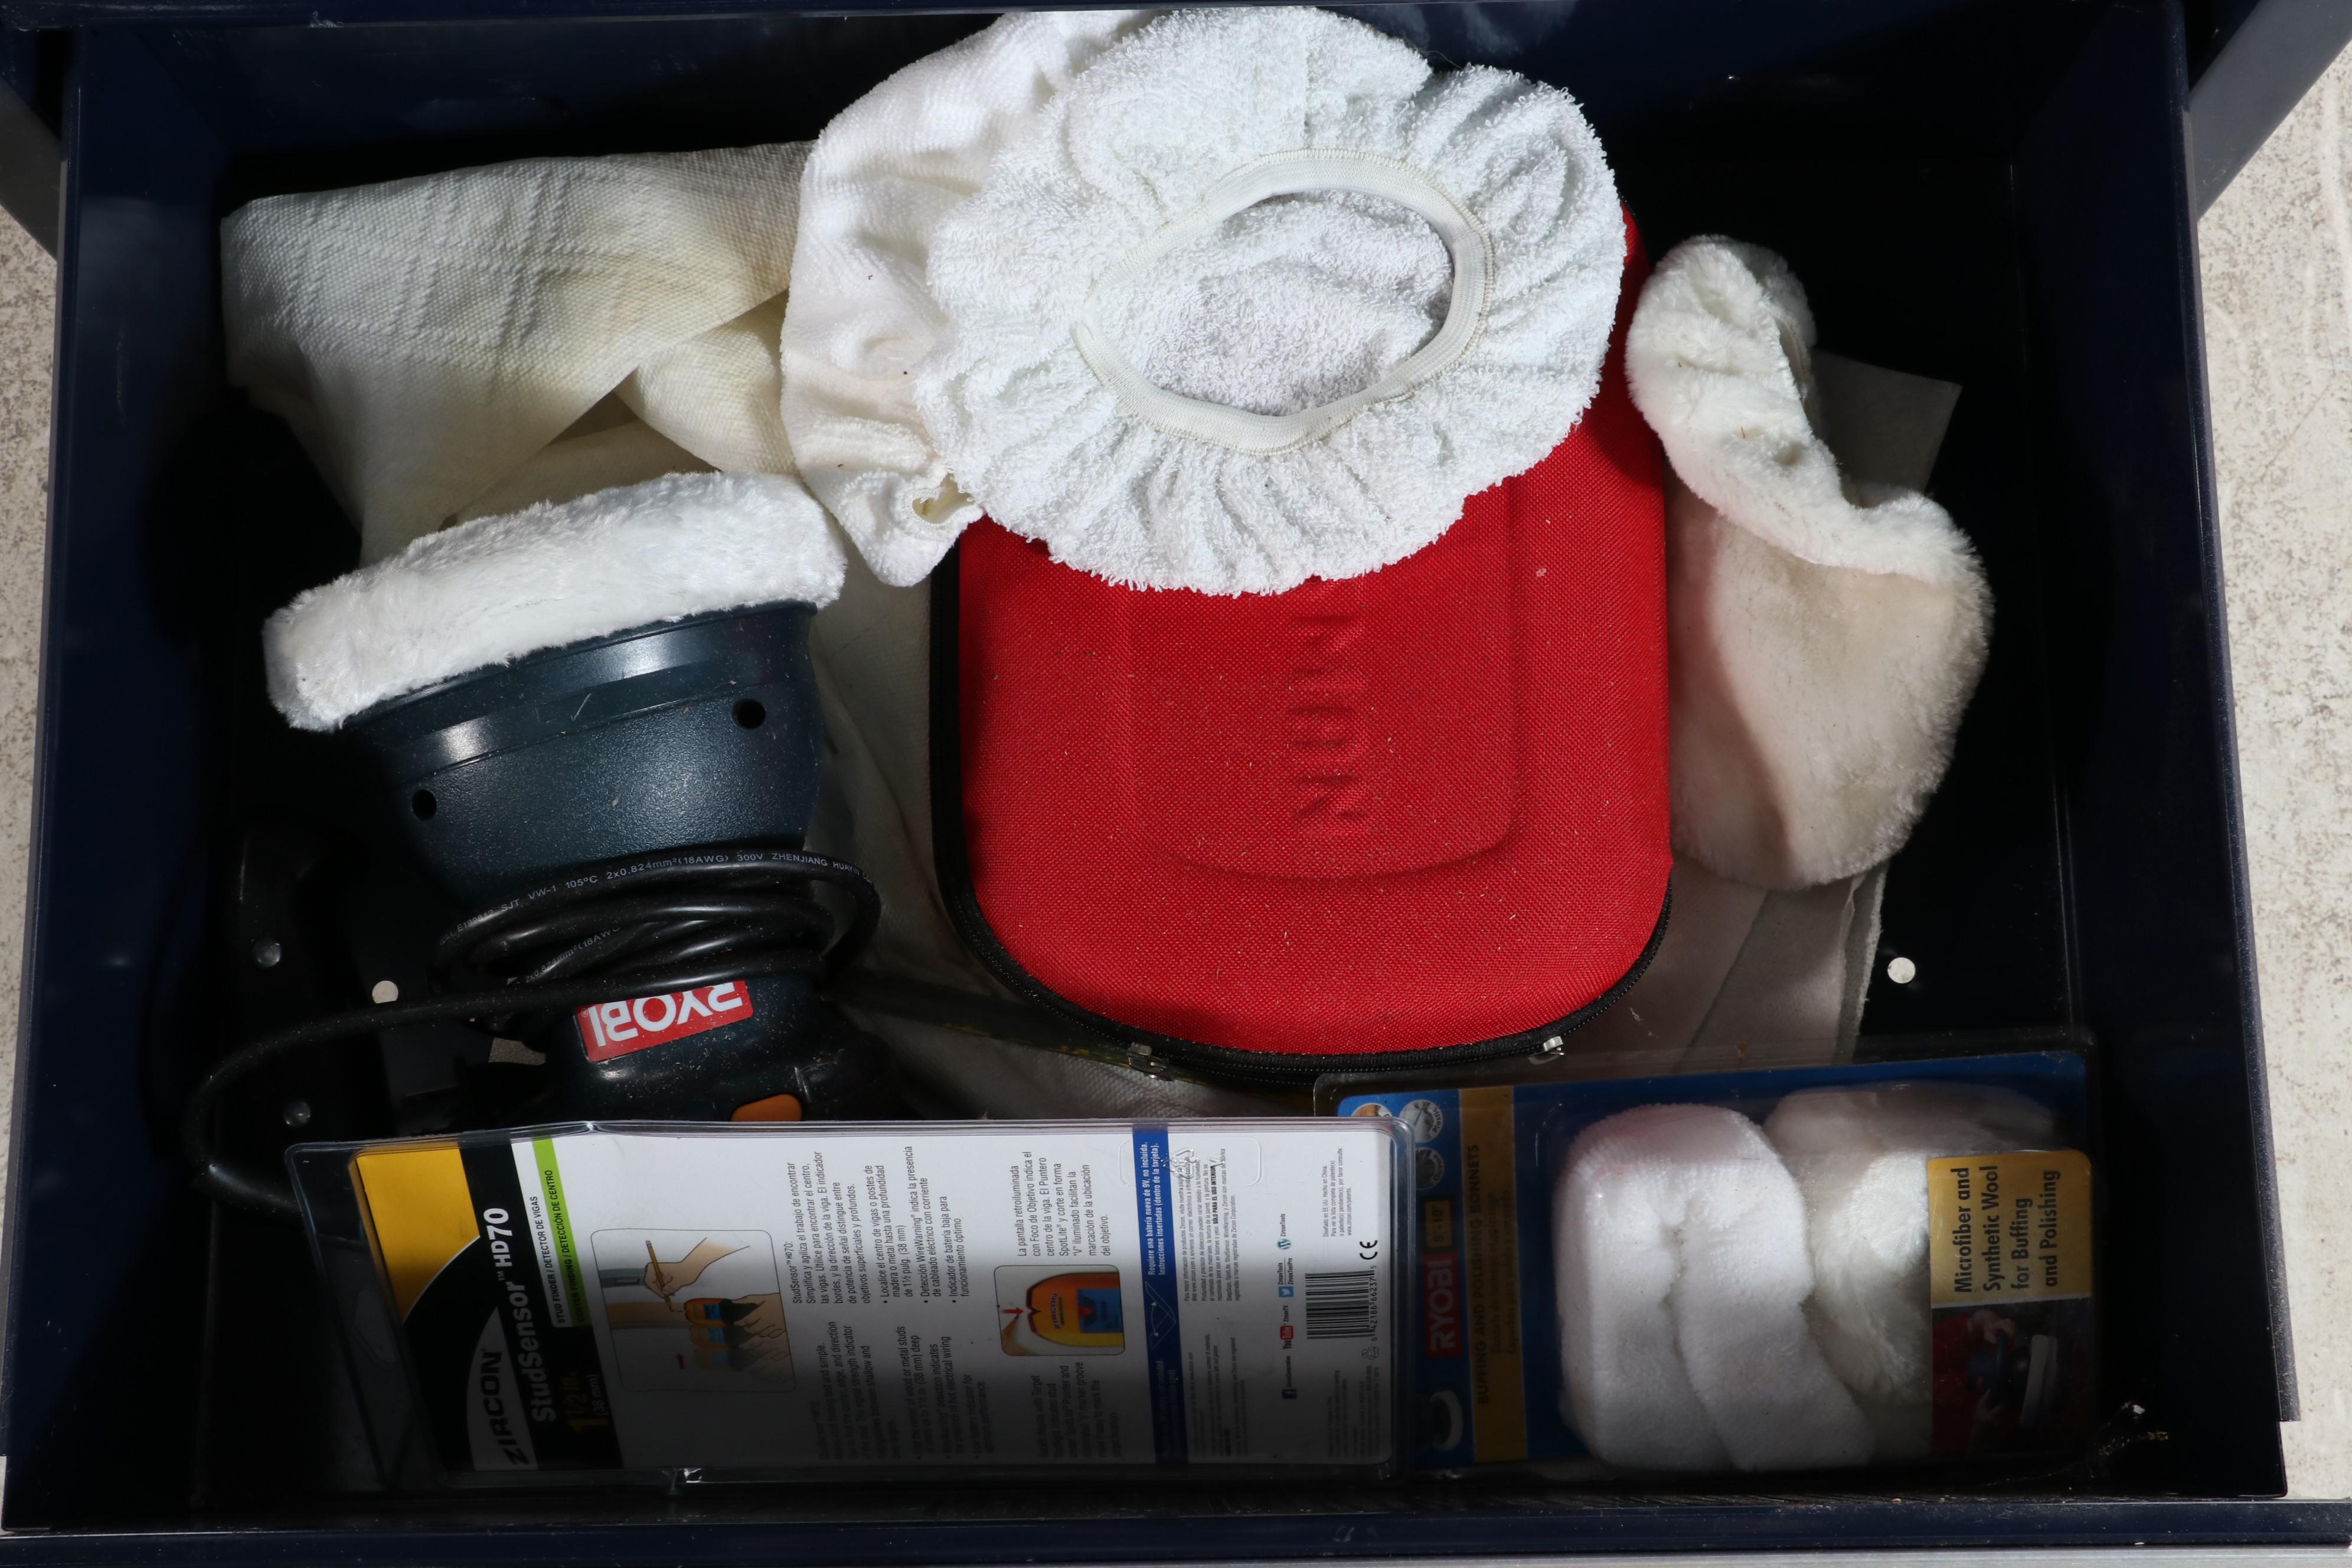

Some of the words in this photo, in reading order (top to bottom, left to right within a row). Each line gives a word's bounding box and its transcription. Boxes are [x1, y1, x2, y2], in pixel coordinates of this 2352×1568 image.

[501, 899, 520, 912] SJT
[528, 885, 557, 900] VW-1
[737, 852, 763, 862] 300V
[772, 852, 828, 867] ZHENJIANG
[588, 982, 743, 1046] RYOBI
[813, 1151, 827, 1184] indicador
[903, 1146, 918, 1180] presencia
[1139, 1142, 1149, 1167] incluida.
[1151, 1143, 1161, 1167] tarjeta).
[786, 1162, 800, 1196] encontrar
[801, 1164, 815, 1188] centro,
[863, 1165, 873, 1174] de
[1023, 1159, 1034, 1181] indica
[1037, 1157, 1048, 1185] Puntero
[1052, 1163, 1063, 1184] forma
[1081, 1165, 1092, 1198] ubicación
[1142, 1178, 1151, 1187] 9V,
[1466, 1143, 1481, 1213] BONNETS
[544, 1170, 558, 1200] CENTRO
[832, 1182, 843, 1200] entre
[865, 1176, 878, 1199] postes
[1010, 1165, 1023, 1217] retroiluminada
[1025, 1183, 1039, 1212] Objetivo
[1067, 1180, 1079, 1207] facilitan
[1153, 1184, 1163, 1205] (dentro
[1951, 1168, 1970, 1200] and
[1979, 1165, 1998, 1210] Wool
[530, 1196, 541, 1218] VIGAS
[550, 1201, 560, 1211] DE
[792, 1198, 802, 1207] de
[806, 1198, 819, 1231] encontrar
[819, 1195, 832, 1211] viga.
[846, 1184, 861, 1221] profundos.
[909, 1191, 920, 1211] indica
[940, 1196, 950, 1211] para
[1040, 1197, 1053, 1213] viga.
[1055, 1198, 1066, 1216] corte
[1084, 1209, 1094, 1217] de
[2037, 1171, 2060, 1249] Polishing
[535, 1220, 544, 1229] DE
[793, 1208, 807, 1232] trabajo
[834, 1202, 850, 1233] distingue
[869, 1208, 882, 1226] vigas
[940, 1213, 952, 1227] baja
[952, 1218, 965, 1242] óptimo
[1027, 1214, 1037, 1223] de
[1043, 1224, 1053, 1232] de
[1070, 1210, 1082, 1243] iluminado
[1098, 1214, 1112, 1243] objetivo.
[1144, 1216, 1153, 1236] batería
[1154, 1207, 1164, 1236] insertadas
[2009, 1198, 2032, 1259] Buffing
[483, 1207, 514, 1266] HD70
[553, 1212, 570, 1253] DETECCIÓN
[812, 1233, 824, 1248] para
[839, 1236, 850, 1253] señal
[871, 1229, 881, 1237] de
[942, 1230, 953, 1252] batería
[1014, 1219, 1028, 1246] pantalla
[1028, 1225, 1039, 1241] Foco
[1044, 1234, 1054, 1256] centro
[1084, 1220, 1096, 1255] marcación
[537, 1231, 552, 1268] DETECTOR
[798, 1242, 812, 1263] agiliza
[813, 1250, 825, 1270] Utilice
[824, 1232, 837, 1263] dirección
[852, 1229, 868, 1272] superficiales
[873, 1239, 884, 1260] centro
[944, 1255, 954, 1263] de
[1032, 1244, 1040, 1256] con
[1100, 1246, 1110, 1256] del
[1156, 1238, 1166, 1274] Instrucciones
[1470, 1218, 1484, 1298] POLISHING
[1952, 1206, 1972, 1292] Microfiber
[1981, 1215, 2004, 1291] Synthetic
[563, 1259, 580, 1289] FINDING
[955, 1244, 969, 1296] funcionamiento
[1146, 1250, 1157, 1275] Requiere
[2039, 1255, 2057, 1286] and
[546, 1274, 560, 1301] FINDER
[802, 1271, 818, 1303] Simplifica
[816, 1273, 830, 1292] vigas.
[843, 1266, 858, 1293] potencia
[858, 1273, 873, 1303] objetivos
[877, 1270, 889, 1296] Localice
[917, 1264, 930, 1296] Detección
[945, 1265, 958, 1296] Indicador
[2010, 1265, 2029, 1289] for
[819, 1294, 829, 1303] las
[831, 1279, 845, 1303] bordes,
[553, 1303, 565, 1323] STUD
[570, 1293, 585, 1322] CENTER
[1426, 1259, 1458, 1351] RYOBI
[1473, 1303, 1486, 1335] AND
[1475, 1340, 1490, 1404] BUFFING
[481, 1351, 529, 1464] ZIRCON
